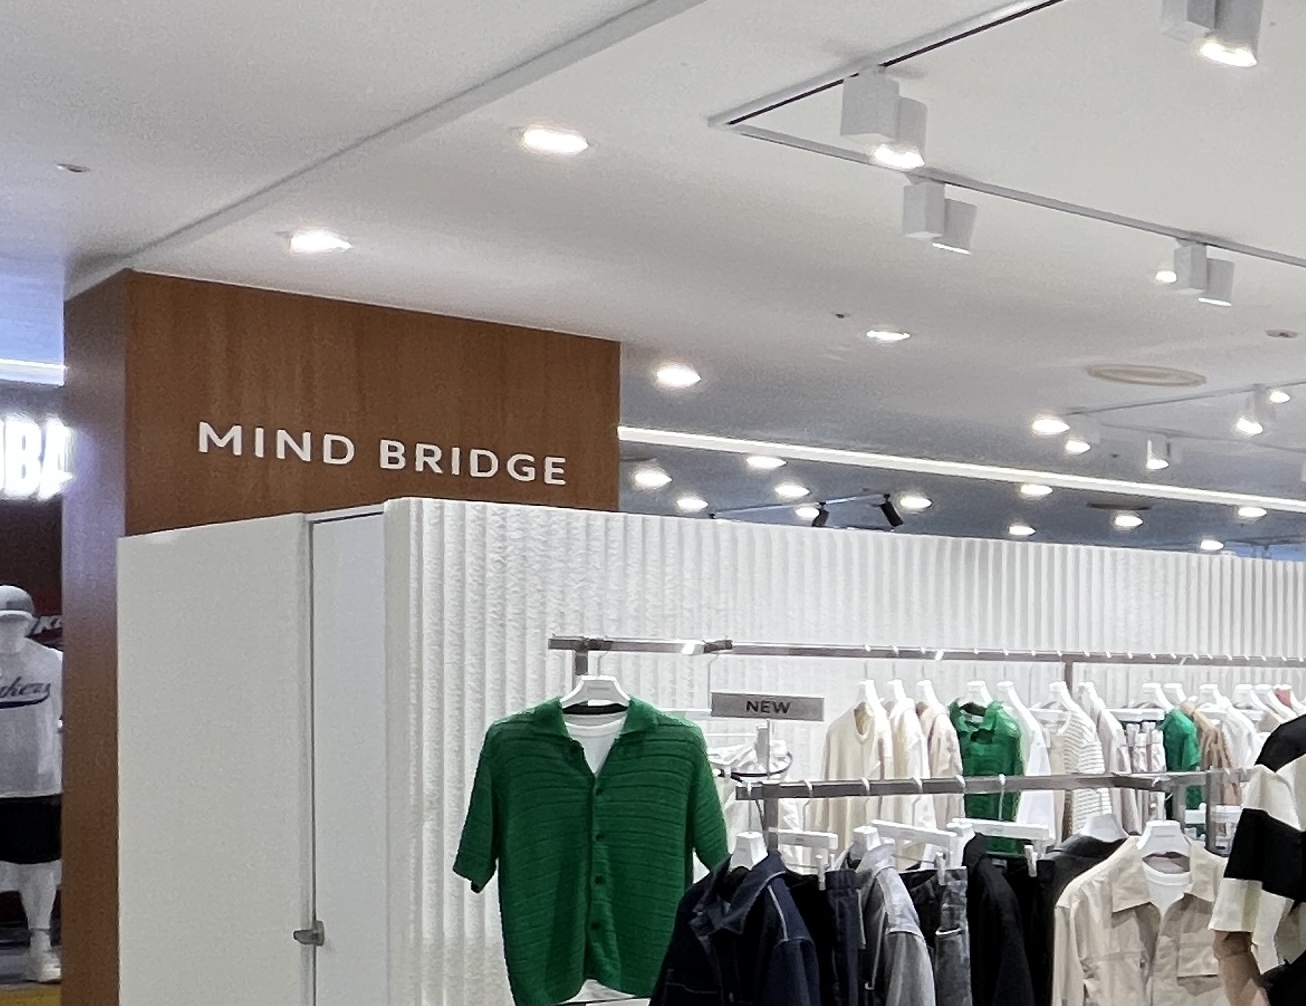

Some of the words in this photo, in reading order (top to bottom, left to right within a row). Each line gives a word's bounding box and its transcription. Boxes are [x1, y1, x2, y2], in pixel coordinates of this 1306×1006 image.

[0, 413, 74, 500] BA
[199, 421, 354, 465] MIND
[380, 439, 566, 485] BRIDGE
[746, 700, 791, 714] NEW
